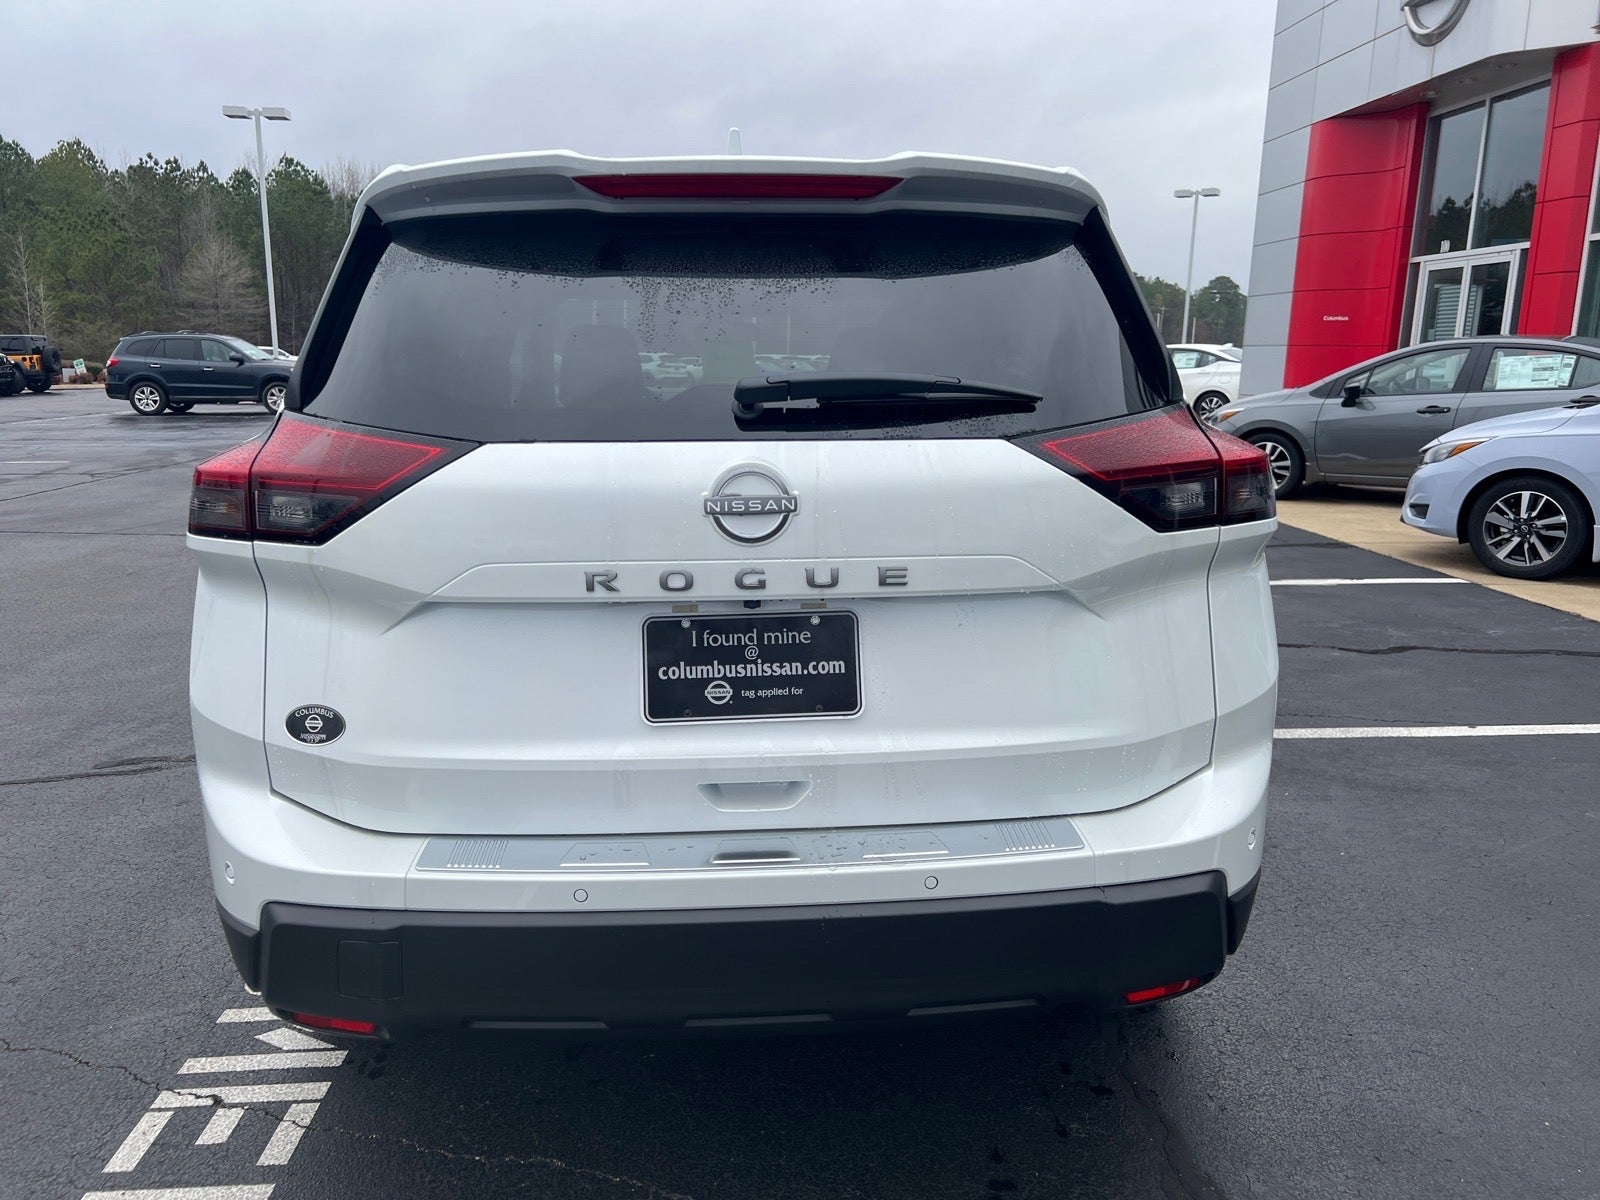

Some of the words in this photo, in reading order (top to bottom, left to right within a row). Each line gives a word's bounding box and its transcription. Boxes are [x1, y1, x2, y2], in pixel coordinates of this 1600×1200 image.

[706, 498, 796, 512] NISSAN
[584, 566, 908, 592] ROGUE
[691, 630, 697, 647] I
[703, 628, 757, 647] found
[763, 628, 812, 644] mine
[744, 646, 759, 660] @
[658, 659, 846, 680] columbusnissan.com
[741, 688, 755, 698] tag
[757, 687, 789, 698] applied
[791, 686, 804, 695] for
[295, 707, 334, 719] COLUMBUS
